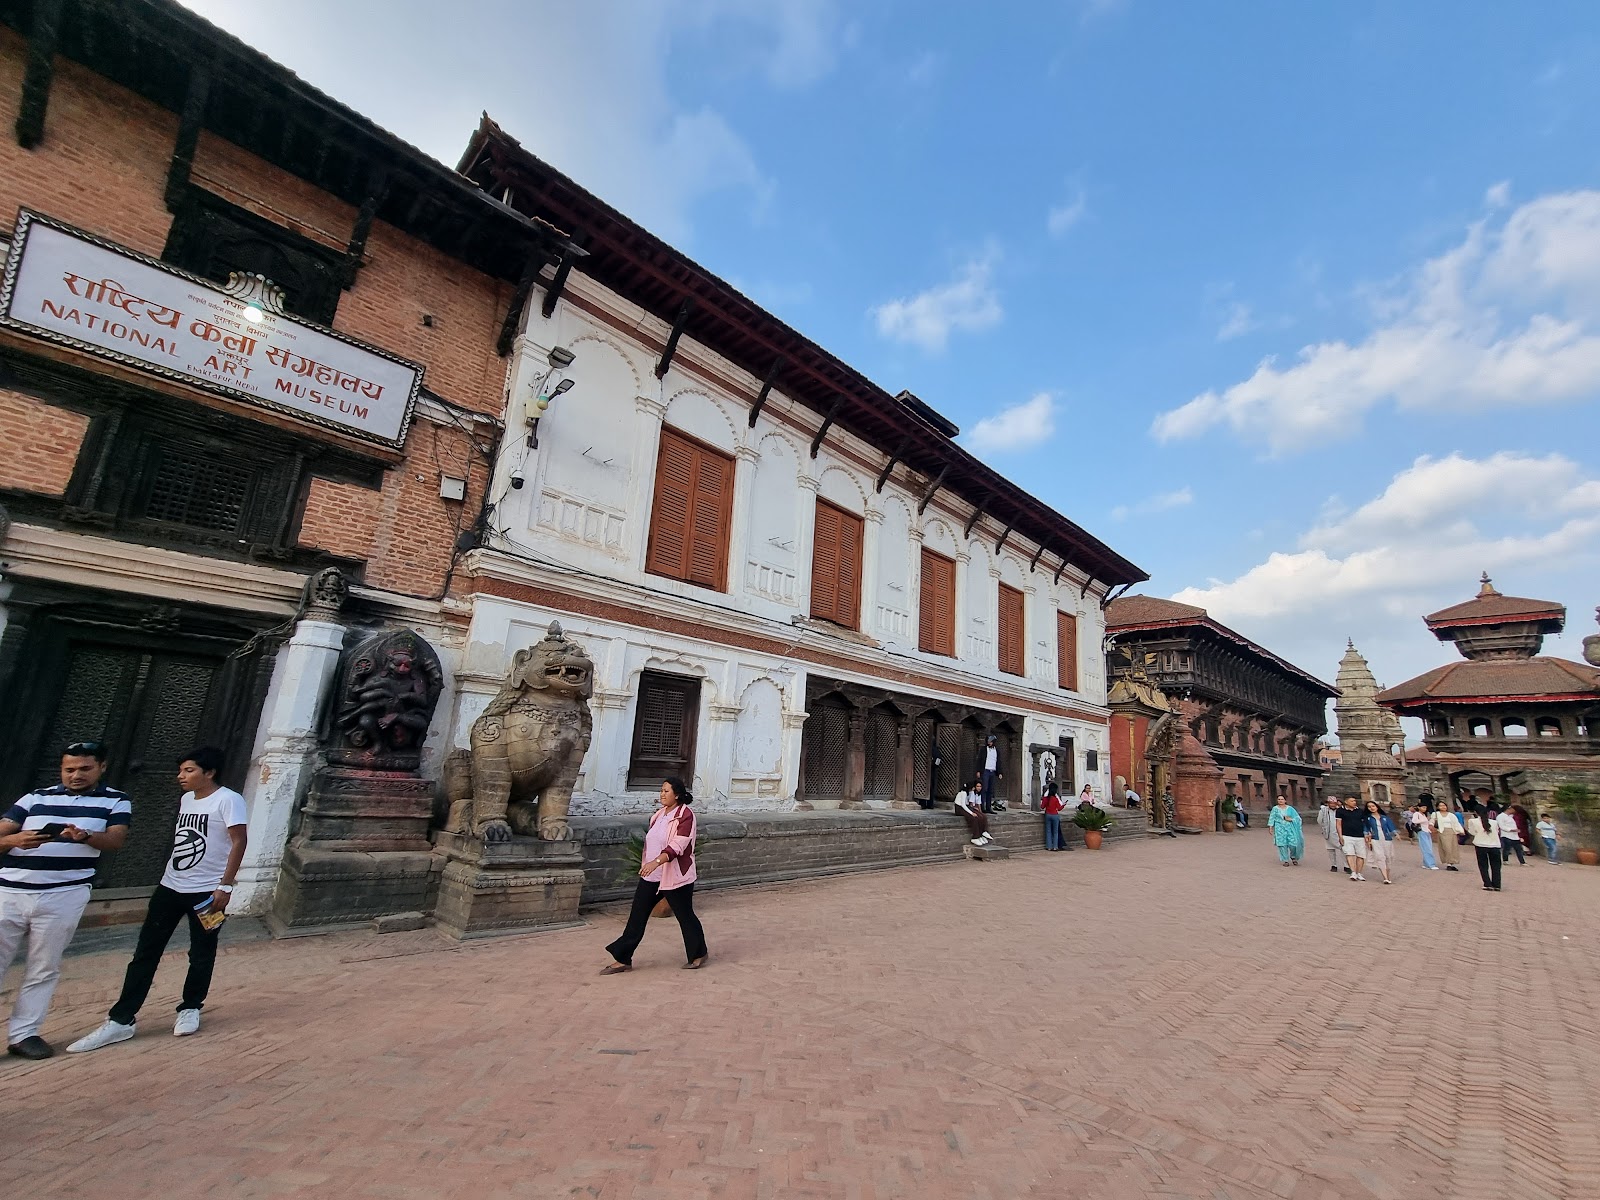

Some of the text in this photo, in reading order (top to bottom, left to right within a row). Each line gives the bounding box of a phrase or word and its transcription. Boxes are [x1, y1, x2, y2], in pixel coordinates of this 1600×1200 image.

[41, 299, 369, 419] NATIONAL ART MUSEUM
[190, 318, 258, 357] कला
[265, 344, 385, 400] संग्रहालय
